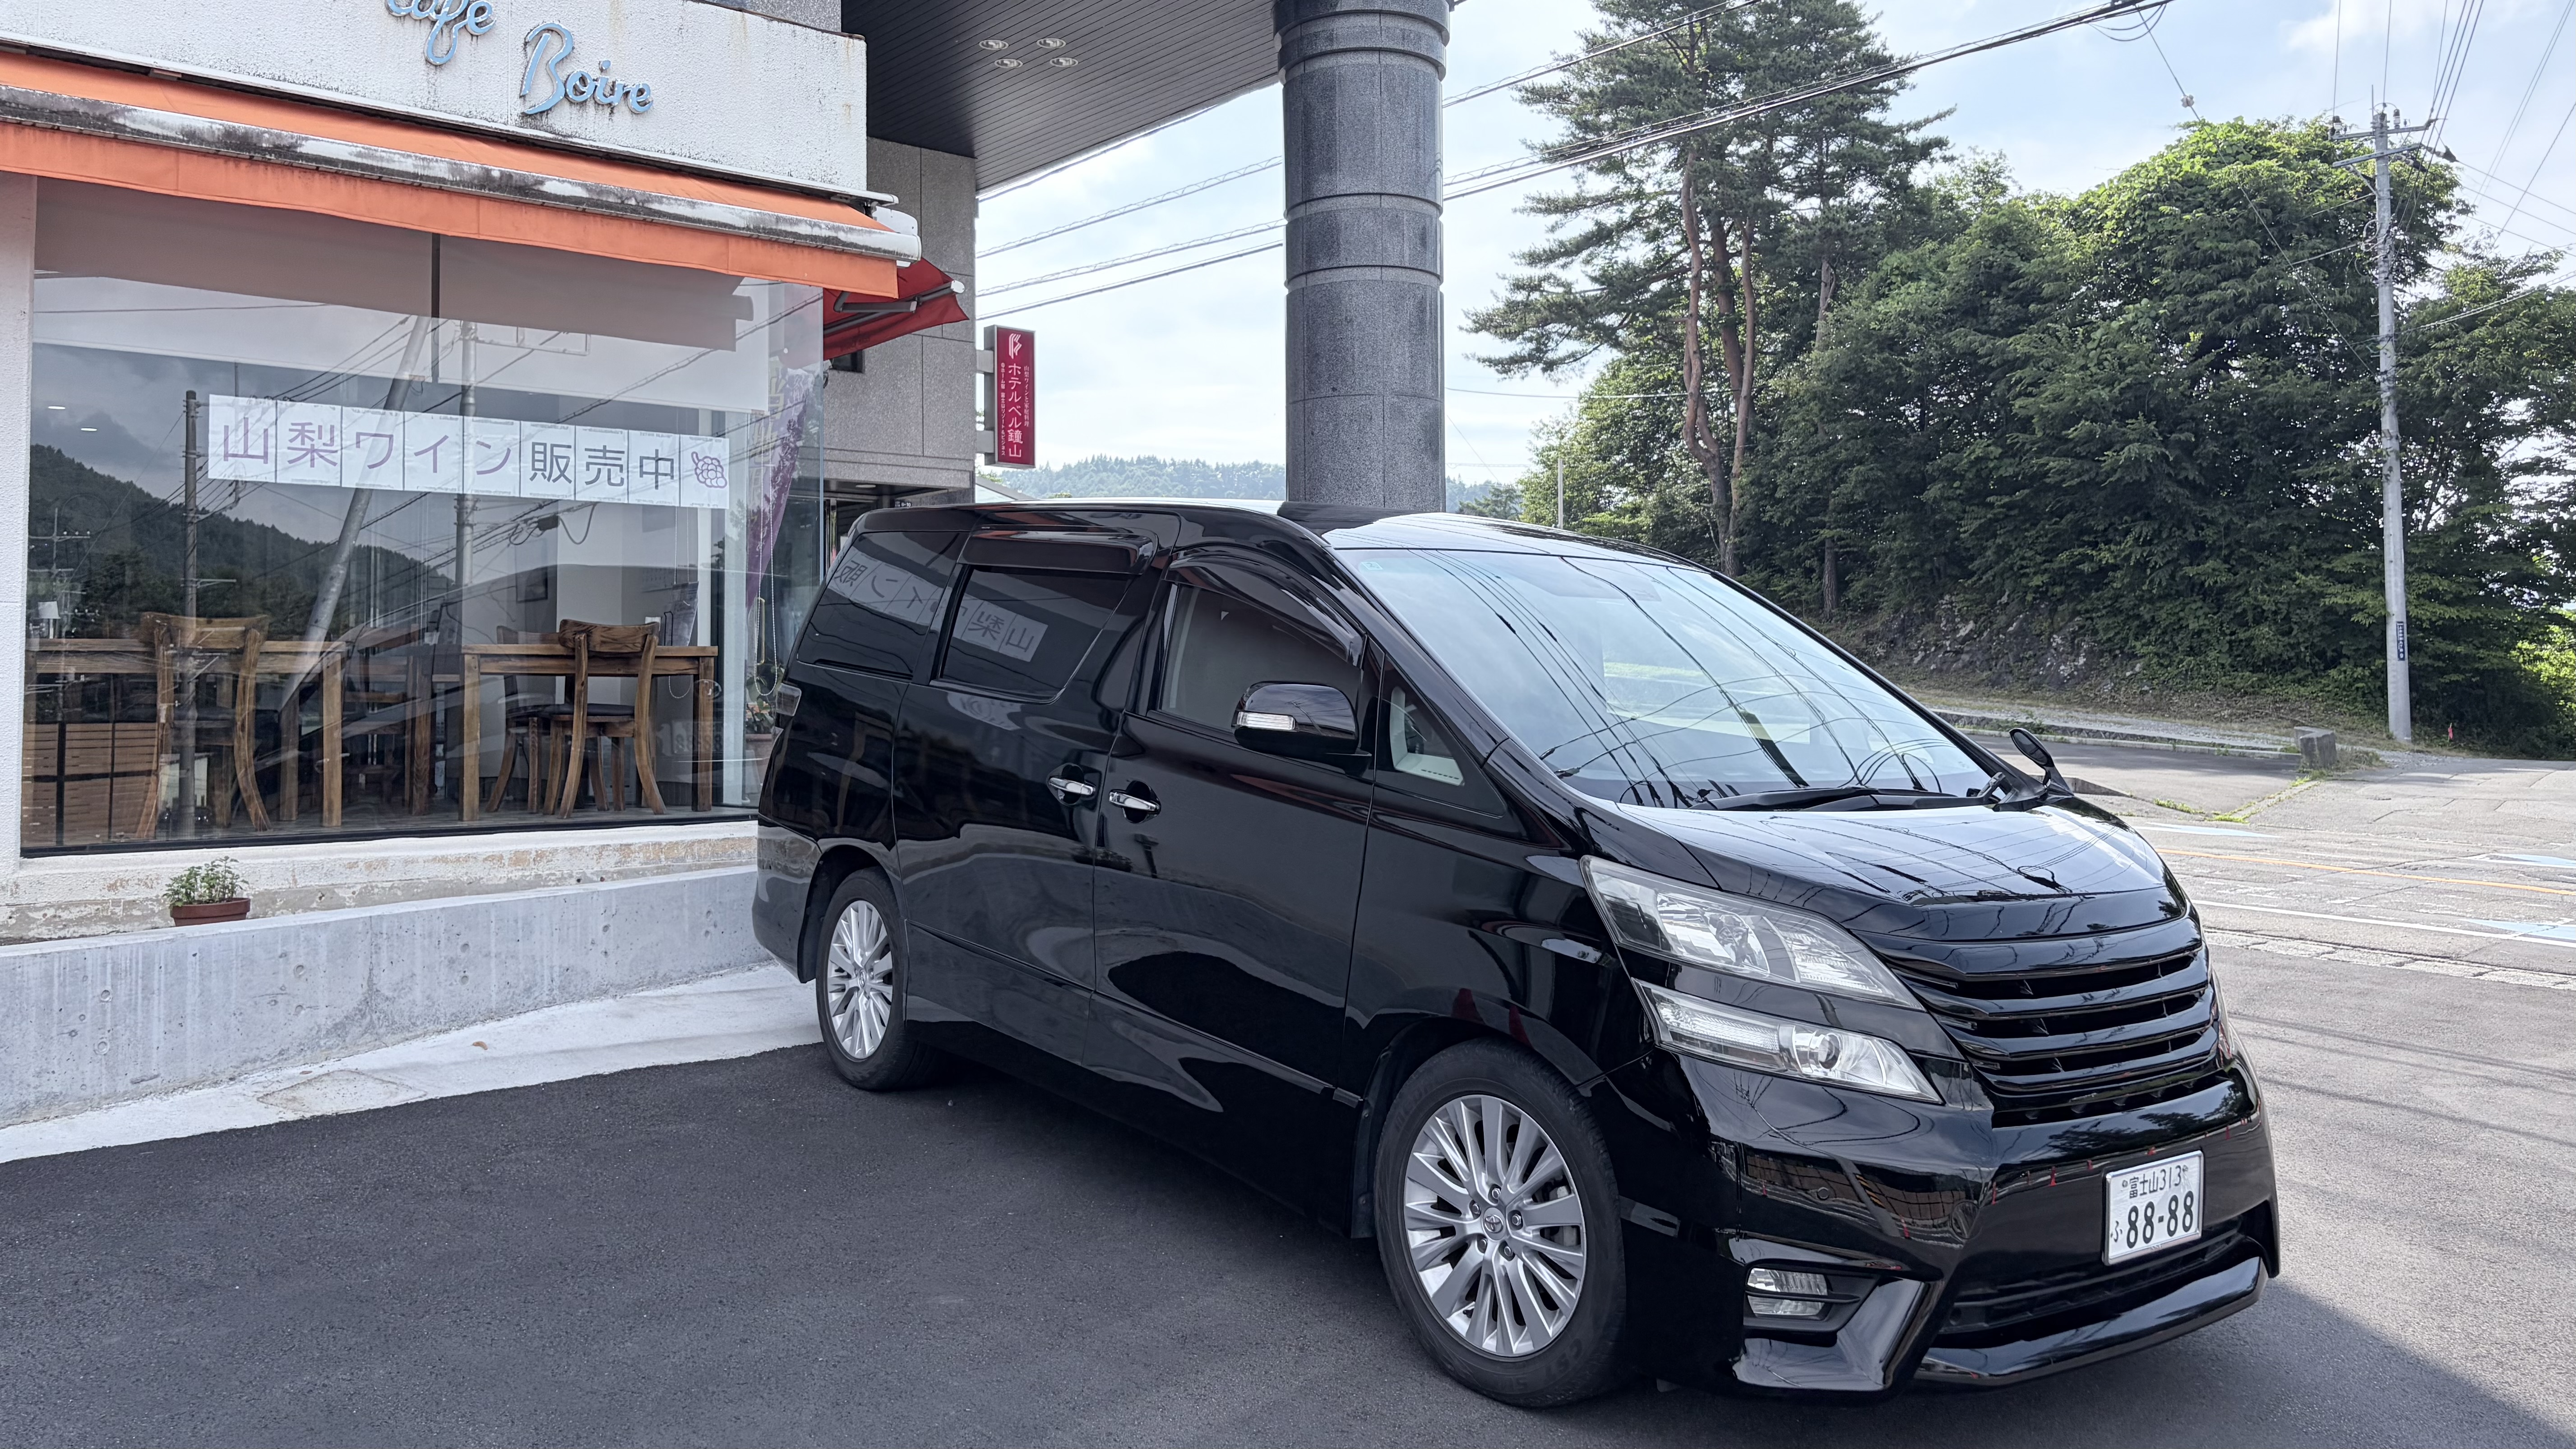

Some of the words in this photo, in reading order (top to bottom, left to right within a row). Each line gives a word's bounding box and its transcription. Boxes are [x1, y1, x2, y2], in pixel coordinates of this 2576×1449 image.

[520, 22, 654, 115] Boire
[223, 415, 675, 490] 山梨ワイン販売中
[1008, 363, 1023, 458] ホテルベル鐘山
[2110, 1220, 2123, 1242] ふ
[2127, 1190, 2194, 1249] 88-88
